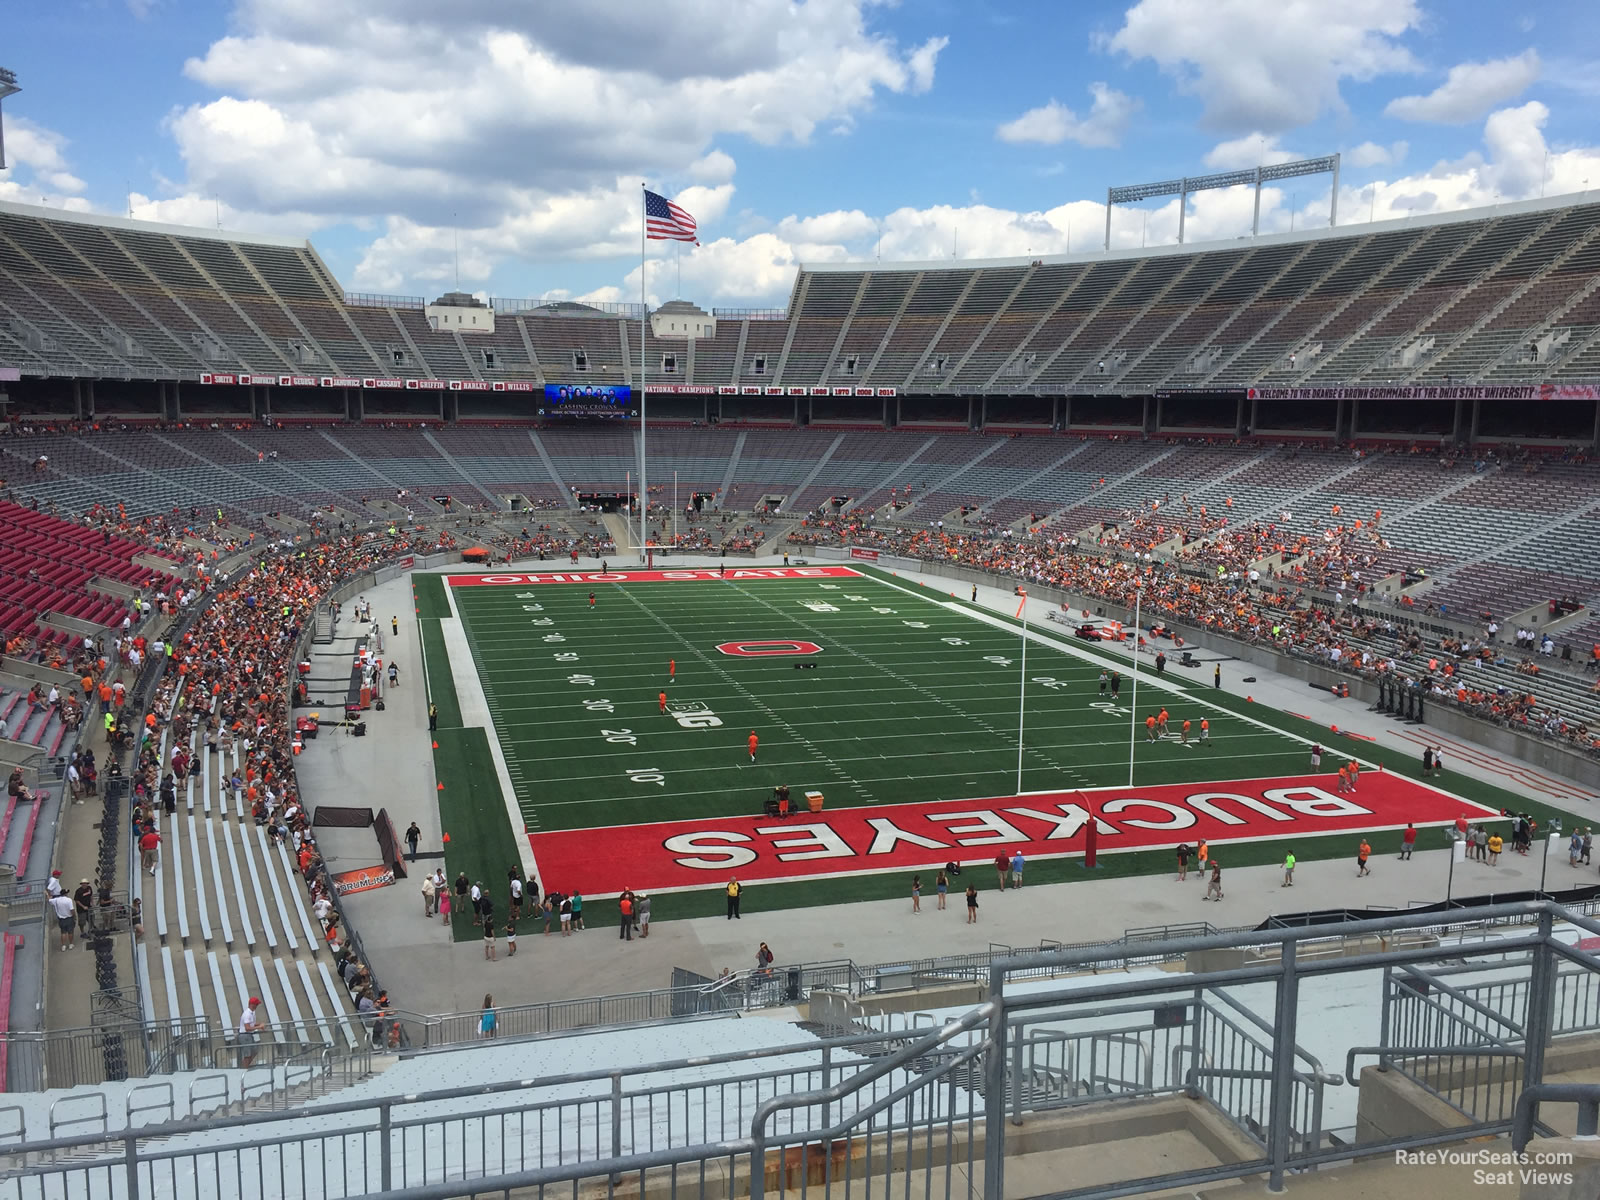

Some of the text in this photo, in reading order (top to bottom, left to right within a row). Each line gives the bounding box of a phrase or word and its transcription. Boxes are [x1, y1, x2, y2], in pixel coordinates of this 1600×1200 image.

[419, 381, 444, 389] GRIFFIN
[463, 382, 487, 390] HARLEY
[507, 383, 530, 391] WILLIS
[677, 386, 714, 394] CHAMPIONS
[1260, 388, 1288, 399] WELCOME
[1290, 388, 1299, 399] TO
[1300, 388, 1312, 399] THE
[1312, 388, 1337, 399] ORANGE
[1344, 388, 1369, 399] BROWN
[1370, 387, 1412, 399] SCRIMMAGE
[1412, 387, 1422, 398] AT
[1424, 387, 1438, 398] THE
[1439, 386, 1458, 398] OHIO
[1459, 386, 1485, 398] STATE
[1485, 386, 1536, 398] UNIVERSITY
[480, 574, 628, 583] OHIO
[662, 569, 832, 579] STATE
[553, 652, 579, 662] 50
[566, 673, 596, 685] 40
[1031, 676, 1068, 687] 30
[582, 698, 615, 711] 30
[1088, 701, 1132, 714] 20
[600, 728, 637, 743] 20
[625, 767, 665, 783] 10
[662, 786, 1376, 870] BUCKEYES
[340, 874, 391, 892] DRUMLINE
